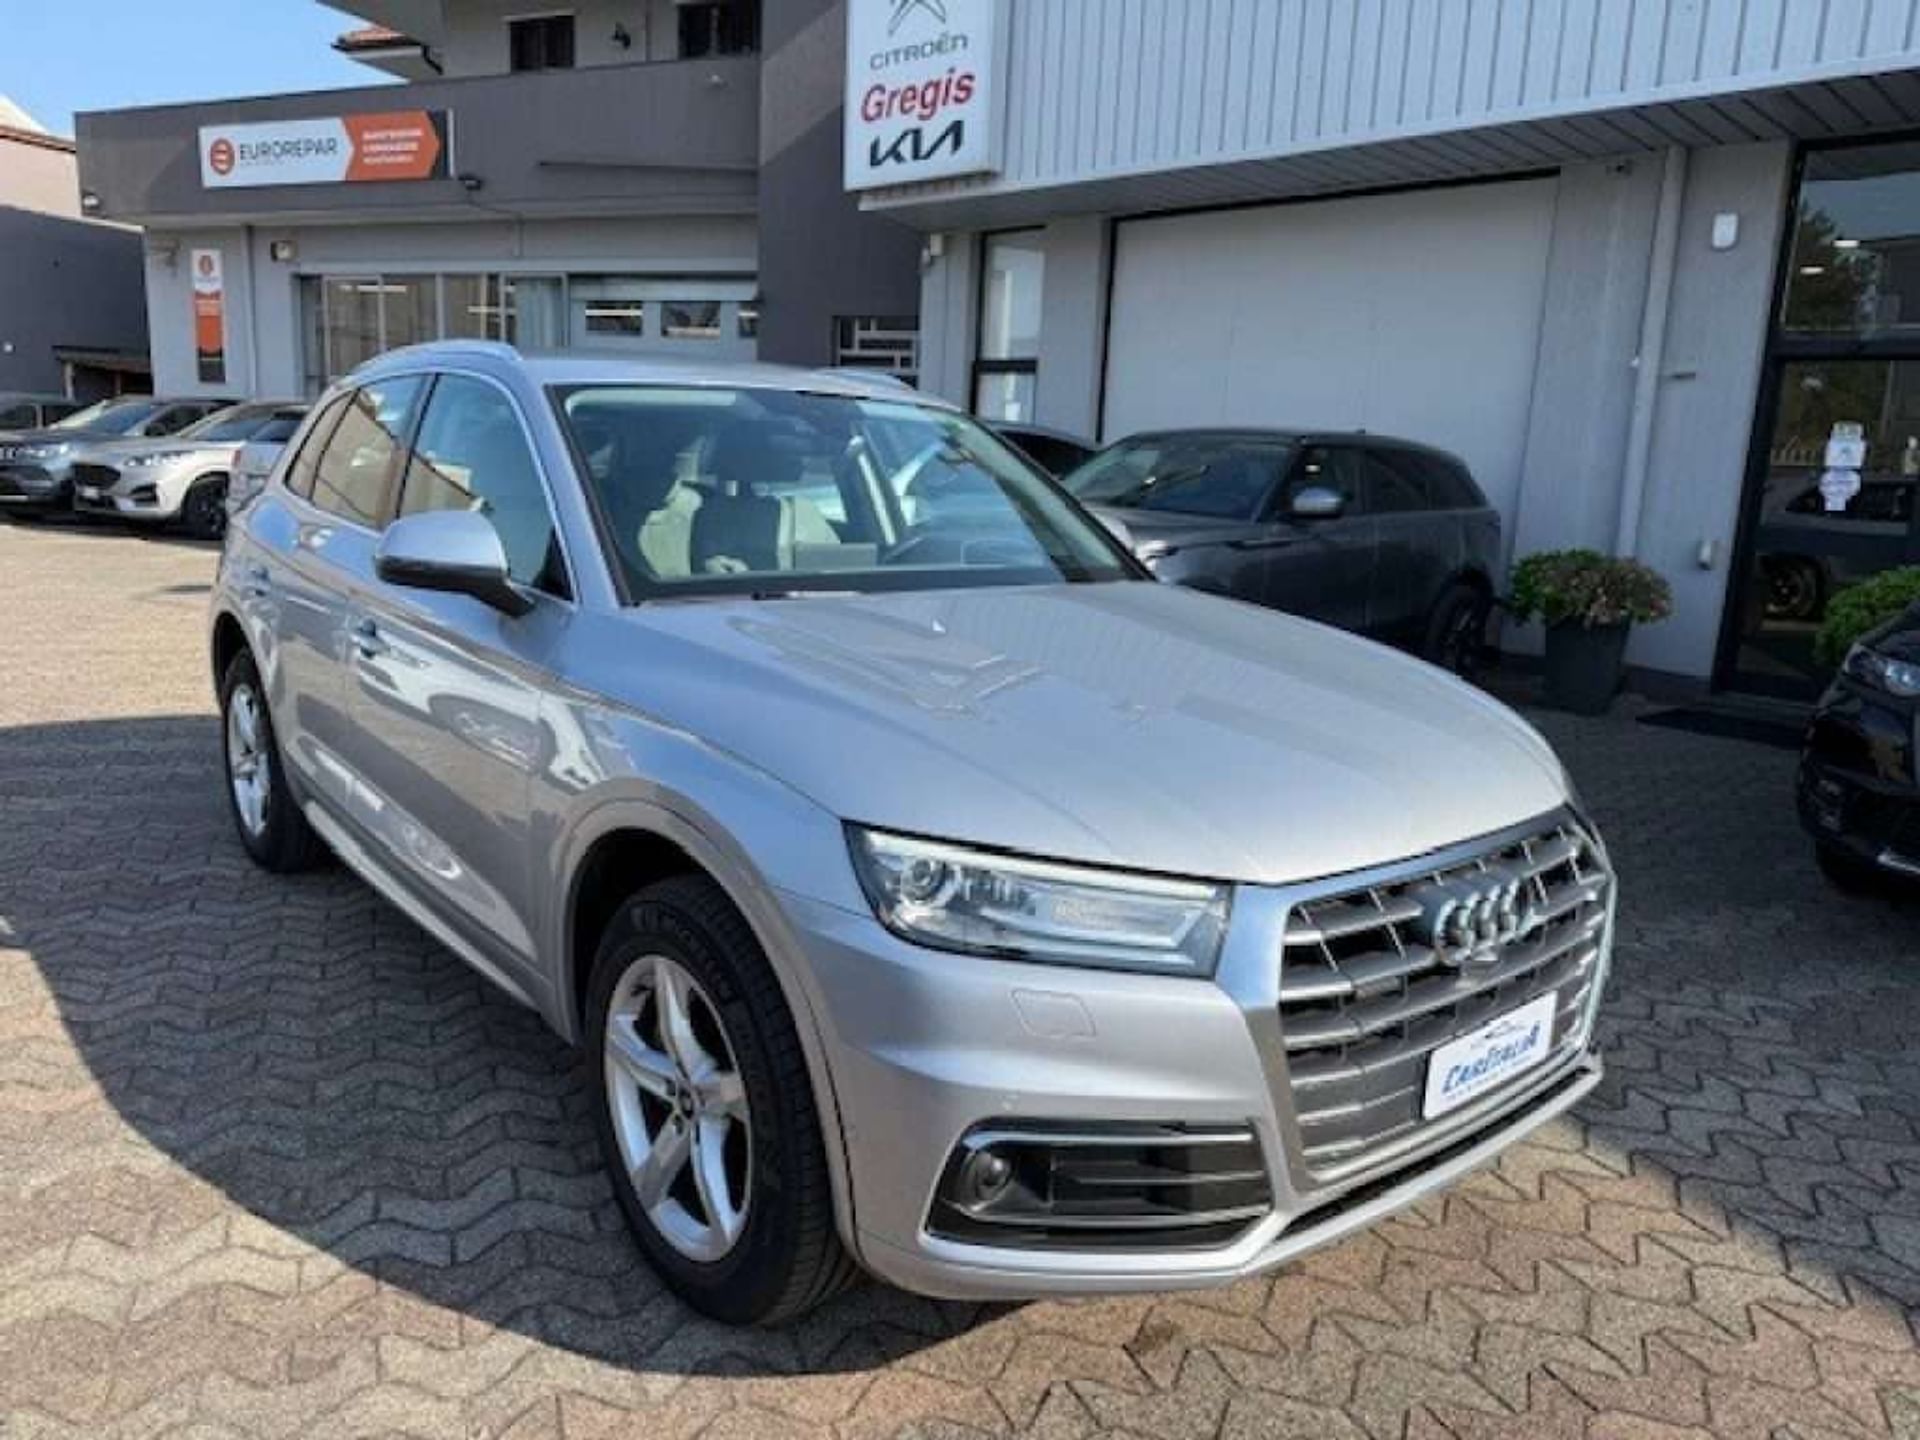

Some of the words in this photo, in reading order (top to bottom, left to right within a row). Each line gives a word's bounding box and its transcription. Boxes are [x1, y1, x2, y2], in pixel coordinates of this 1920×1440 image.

[861, 67, 976, 123] Gregis
[239, 137, 338, 161] EUROREPAR
[869, 120, 965, 167] KIA
